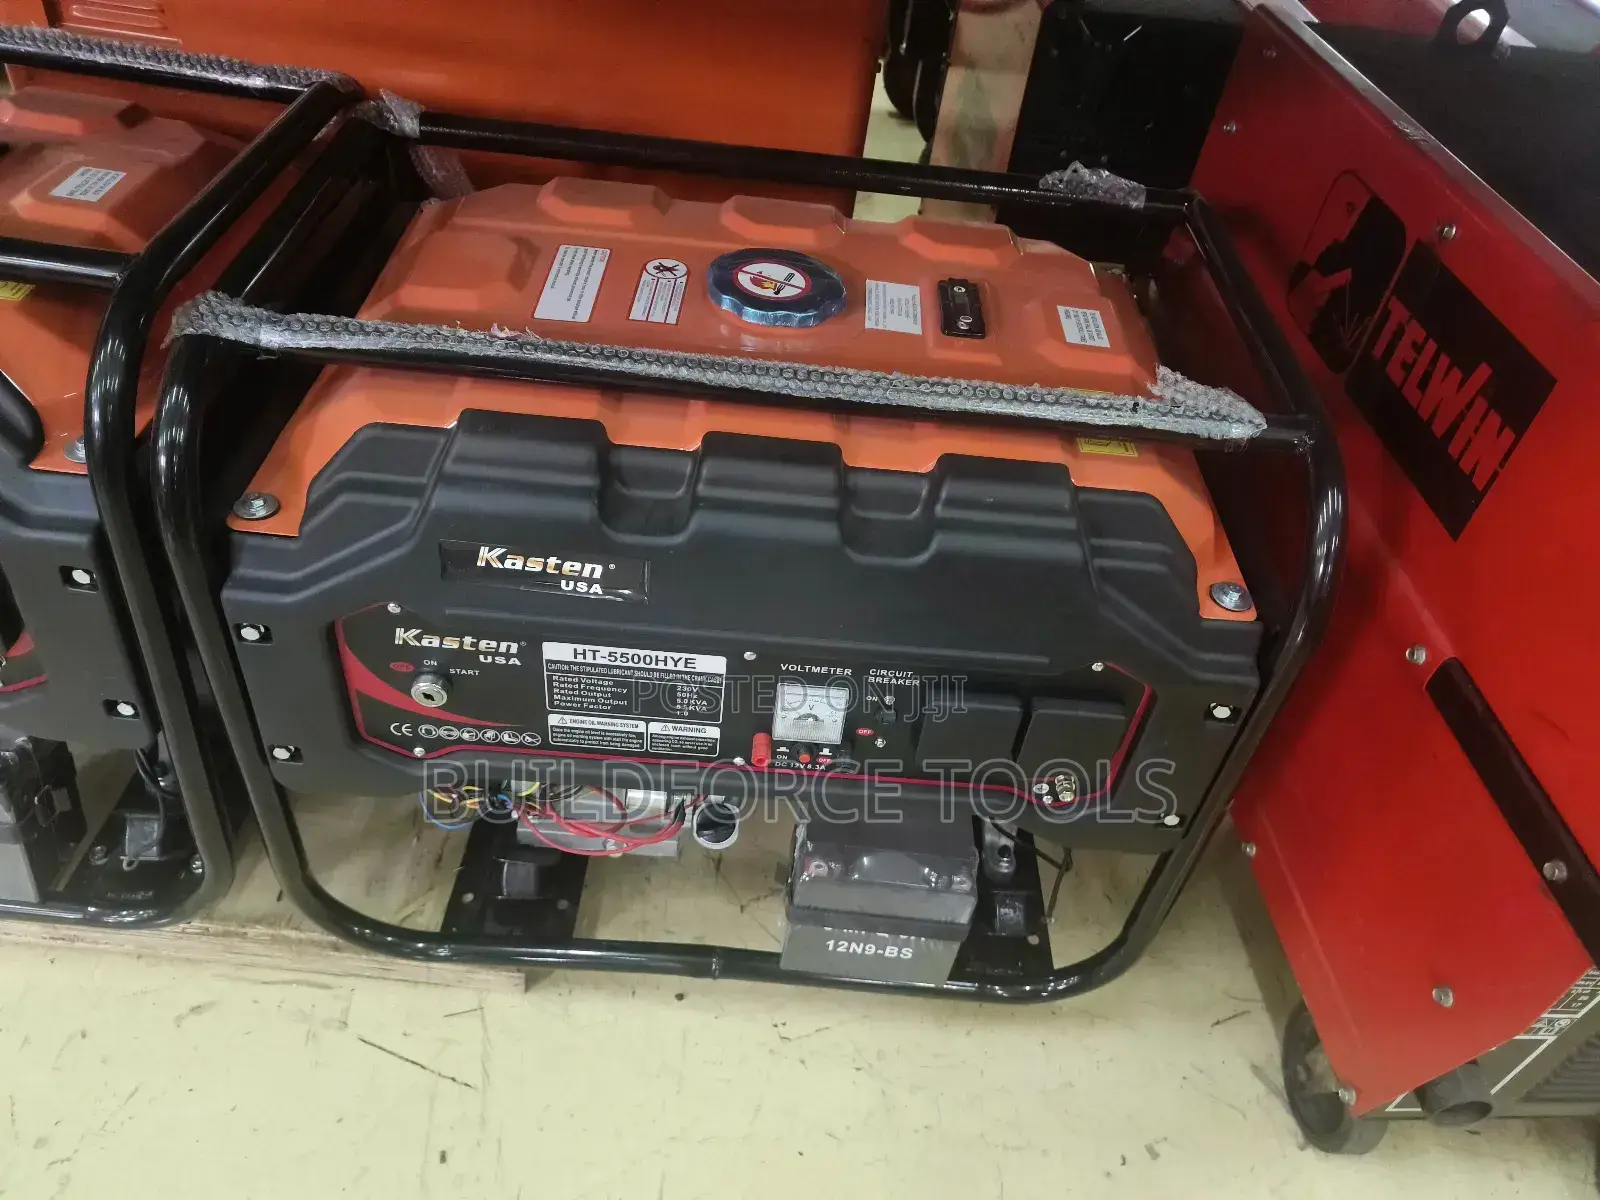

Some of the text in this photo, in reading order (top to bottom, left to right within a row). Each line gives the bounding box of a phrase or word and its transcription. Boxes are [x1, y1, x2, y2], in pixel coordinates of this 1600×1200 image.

[560, 579, 603, 595] USA
[478, 654, 522, 666] USA
[573, 648, 697, 670] HT-5500HYE
[449, 668, 480, 676] START
[780, 663, 852, 676] VOLTMETER
[869, 668, 914, 678] CIRCUIT
[581, 678, 614, 686] Voltage
[867, 677, 920, 686] BREAKER
[581, 684, 627, 693] Frequency
[581, 690, 611, 698] Output
[554, 695, 596, 703] Maximum
[554, 700, 612, 710] Power Factor
[671, 725, 707, 734] WARNING
[825, 939, 914, 960] 12N9-BS
